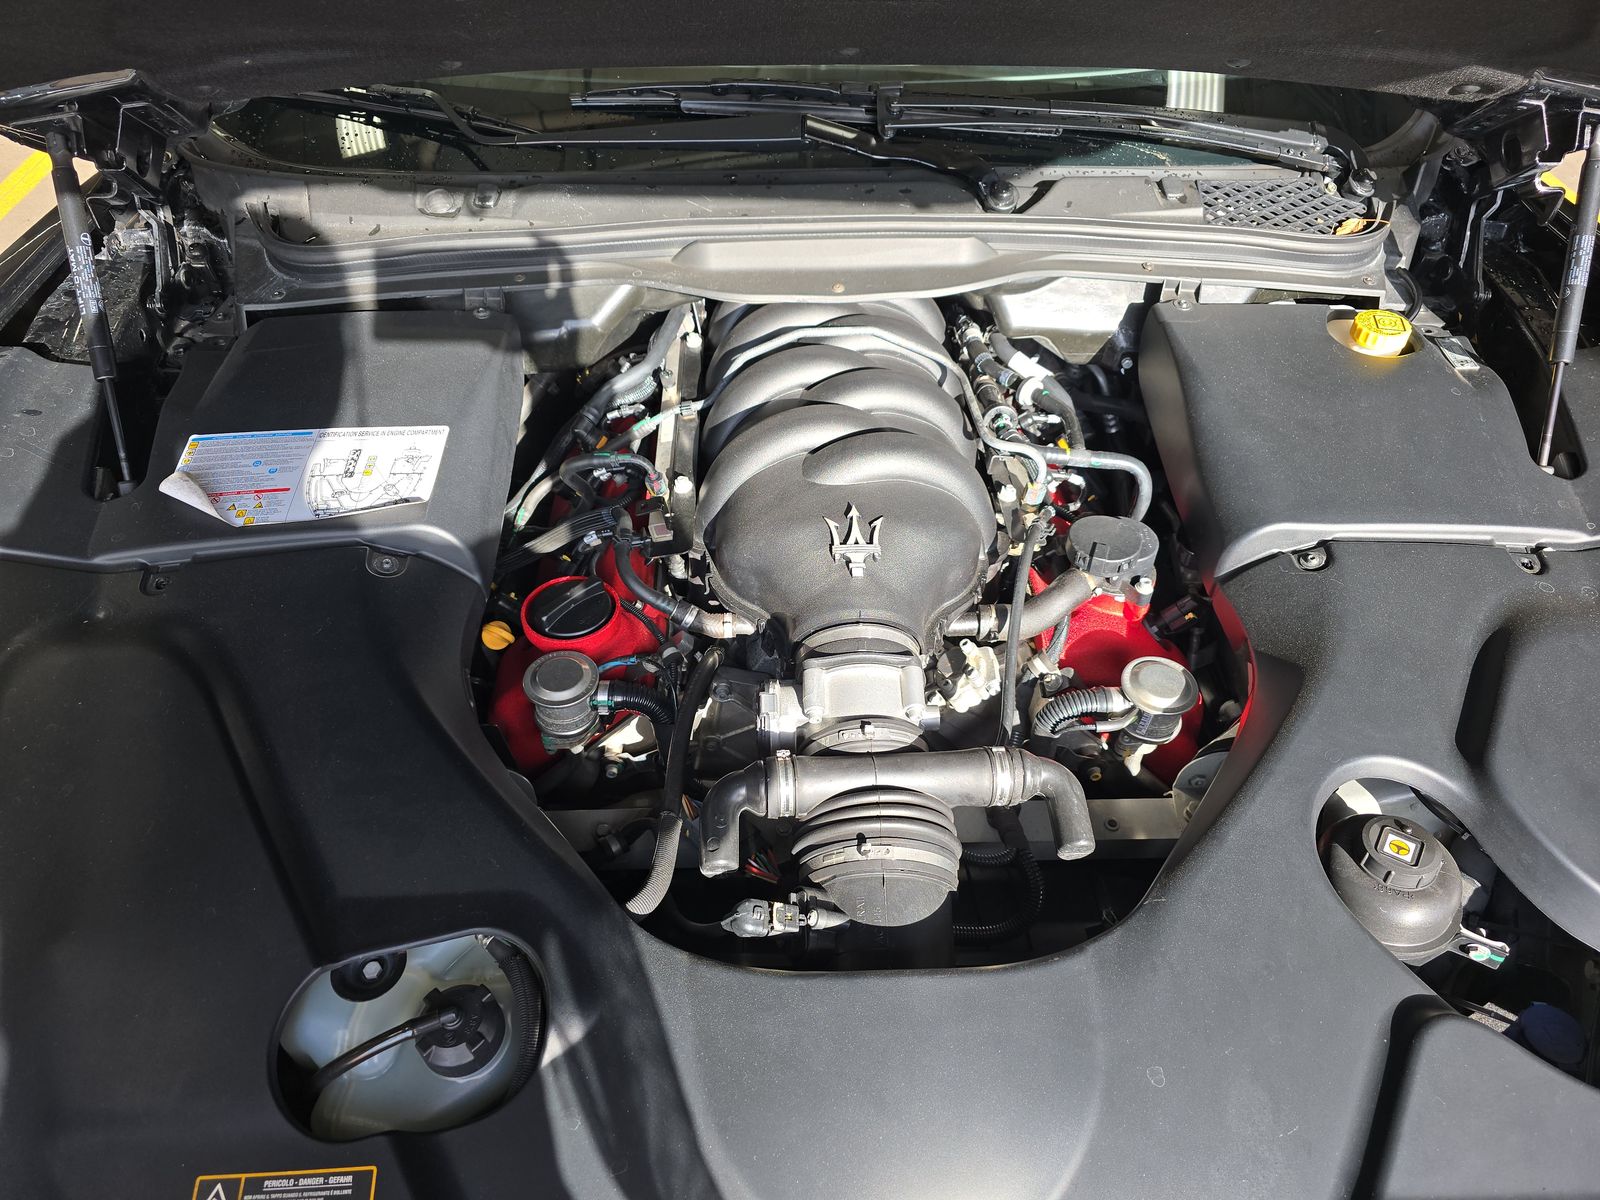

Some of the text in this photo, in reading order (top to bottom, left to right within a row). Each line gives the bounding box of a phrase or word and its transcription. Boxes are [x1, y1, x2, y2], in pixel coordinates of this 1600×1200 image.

[406, 428, 445, 436] COMPARTMENT
[264, 1179, 294, 1188] PERICOLO
[298, 1177, 324, 1186] DANGER
[328, 1175, 353, 1184] GEFAHR
